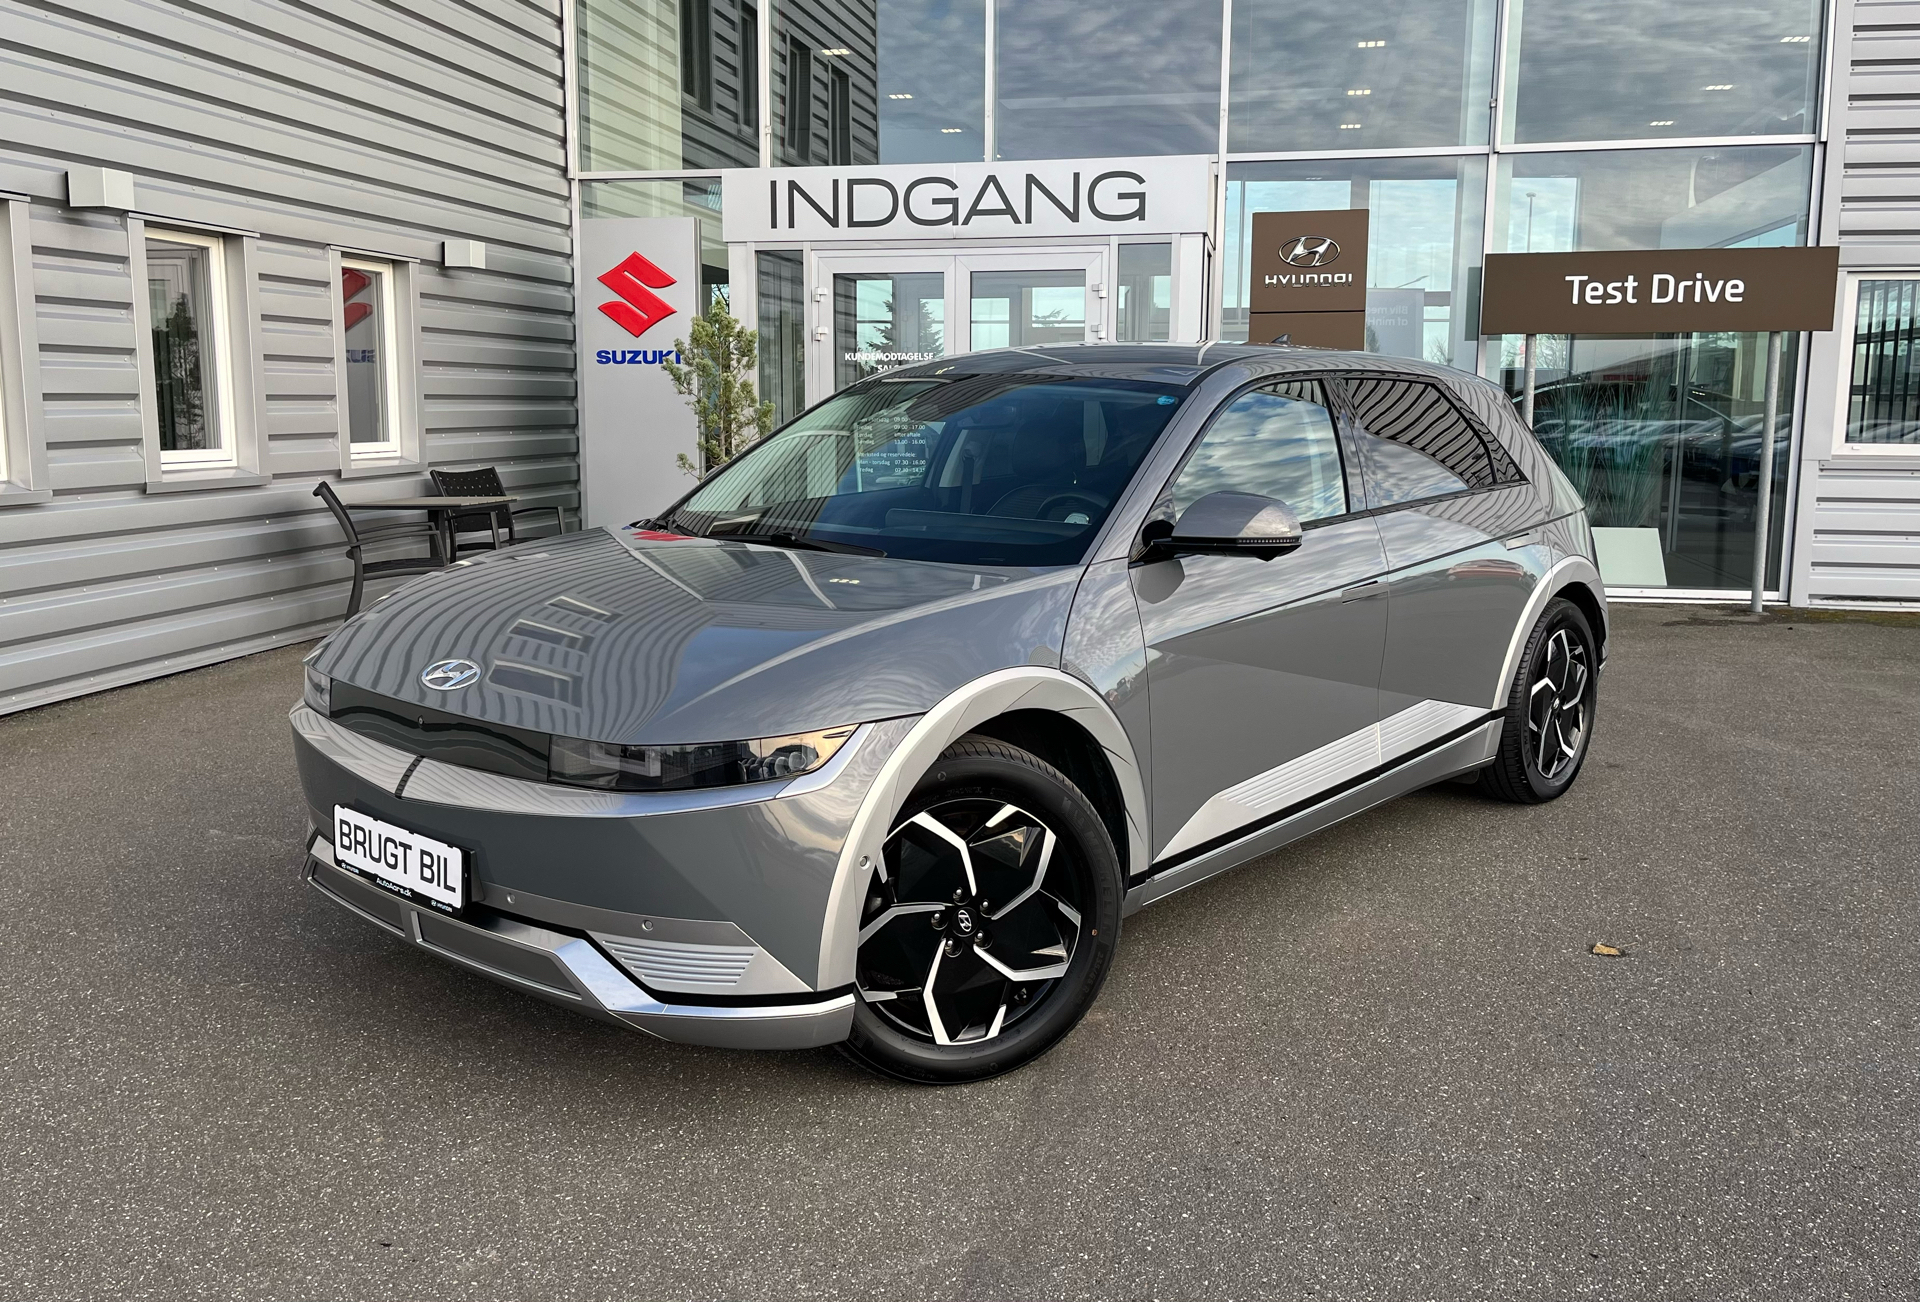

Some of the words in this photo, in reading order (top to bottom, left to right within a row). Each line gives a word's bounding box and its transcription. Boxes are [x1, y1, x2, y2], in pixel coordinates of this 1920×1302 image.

[770, 170, 1147, 230] INDGANG
[1264, 272, 1353, 287] HYUNDAI
[1565, 274, 1638, 305] Test
[1651, 272, 1745, 304] Drive
[596, 349, 681, 365] SUZUKI
[339, 818, 413, 875] BRUGT
[419, 848, 457, 894] BIL
